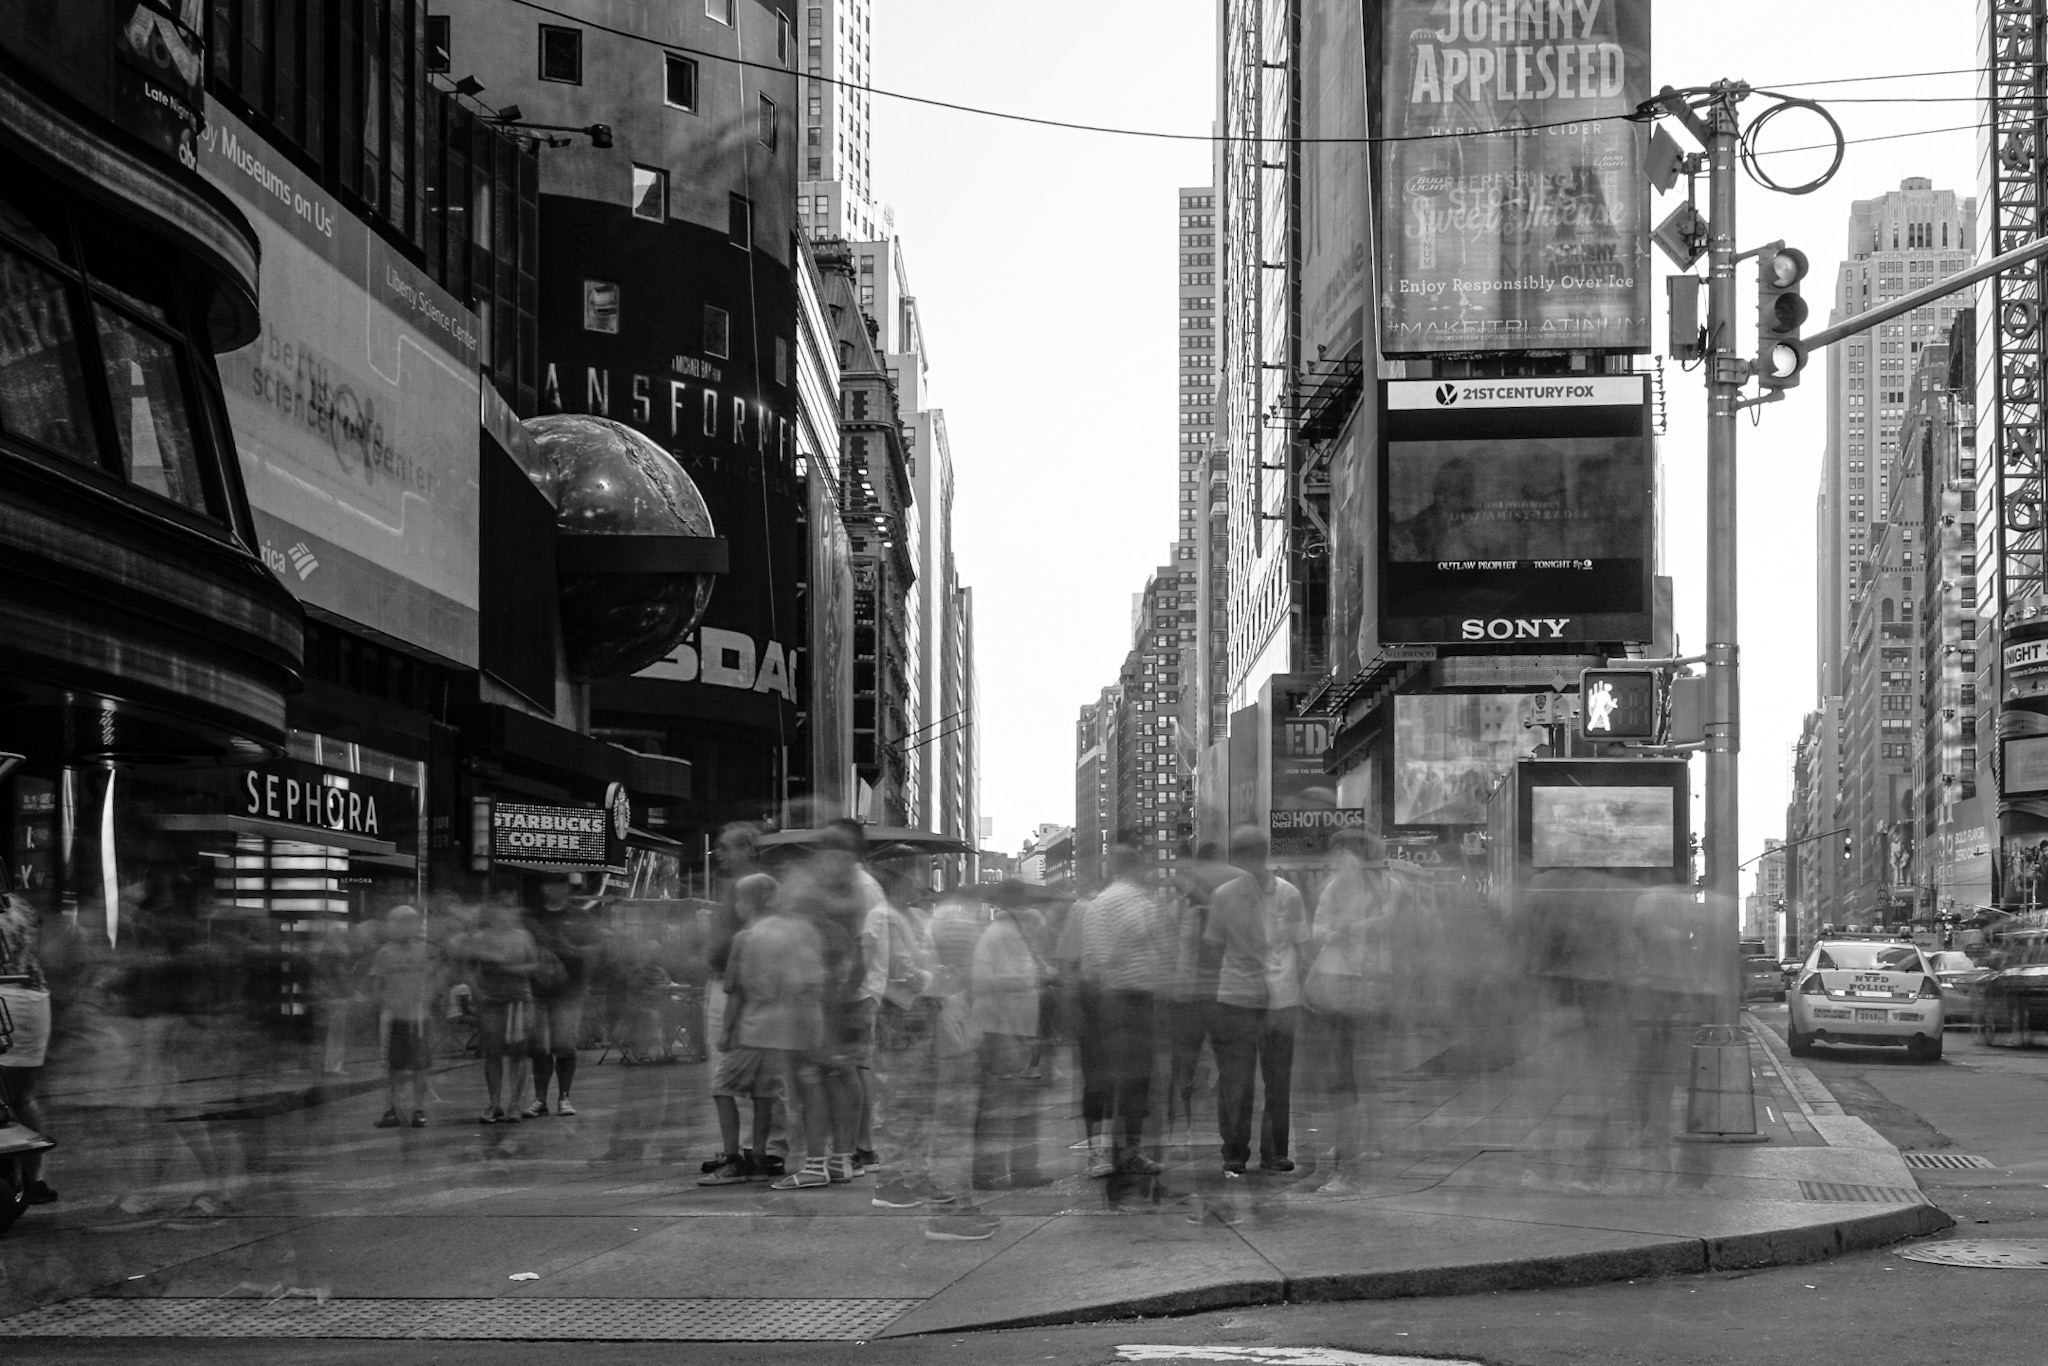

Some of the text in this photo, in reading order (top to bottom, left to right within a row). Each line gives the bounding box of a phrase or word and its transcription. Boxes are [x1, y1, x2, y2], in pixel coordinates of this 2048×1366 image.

[1436, 0, 1600, 43] JOHNNY
[1411, 43, 1625, 103] APPLESEED
[145, 81, 169, 107] Late
[1548, 123, 1602, 136] CIDER
[221, 125, 292, 207] Museums
[295, 192, 312, 223] on
[314, 202, 333, 238] Us
[1410, 184, 1446, 192] LIGHT
[1416, 176, 1444, 184] BUD
[1399, 274, 1635, 296] Enjoy Responsibly Over Ice
[386, 267, 478, 350] Liberty Science Center
[1463, 384, 1595, 400] 21ST CENTURY FOX
[1437, 561, 1477, 571] OUTLAW
[1478, 560, 1517, 570] PROPHET
[1533, 560, 1572, 569] TONIGHT
[1461, 618, 1571, 640] SONY
[1384, 648, 1436, 659] SHERWOOD
[246, 770, 379, 834] SEPHORA
[494, 812, 604, 833] STARBUCKS
[1293, 811, 1321, 828] HOT
[1323, 810, 1362, 826] DOGS
[508, 831, 581, 850] COFFEE
[1849, 984, 1895, 992] POLICE
[1855, 975, 1889, 984] NYPD
